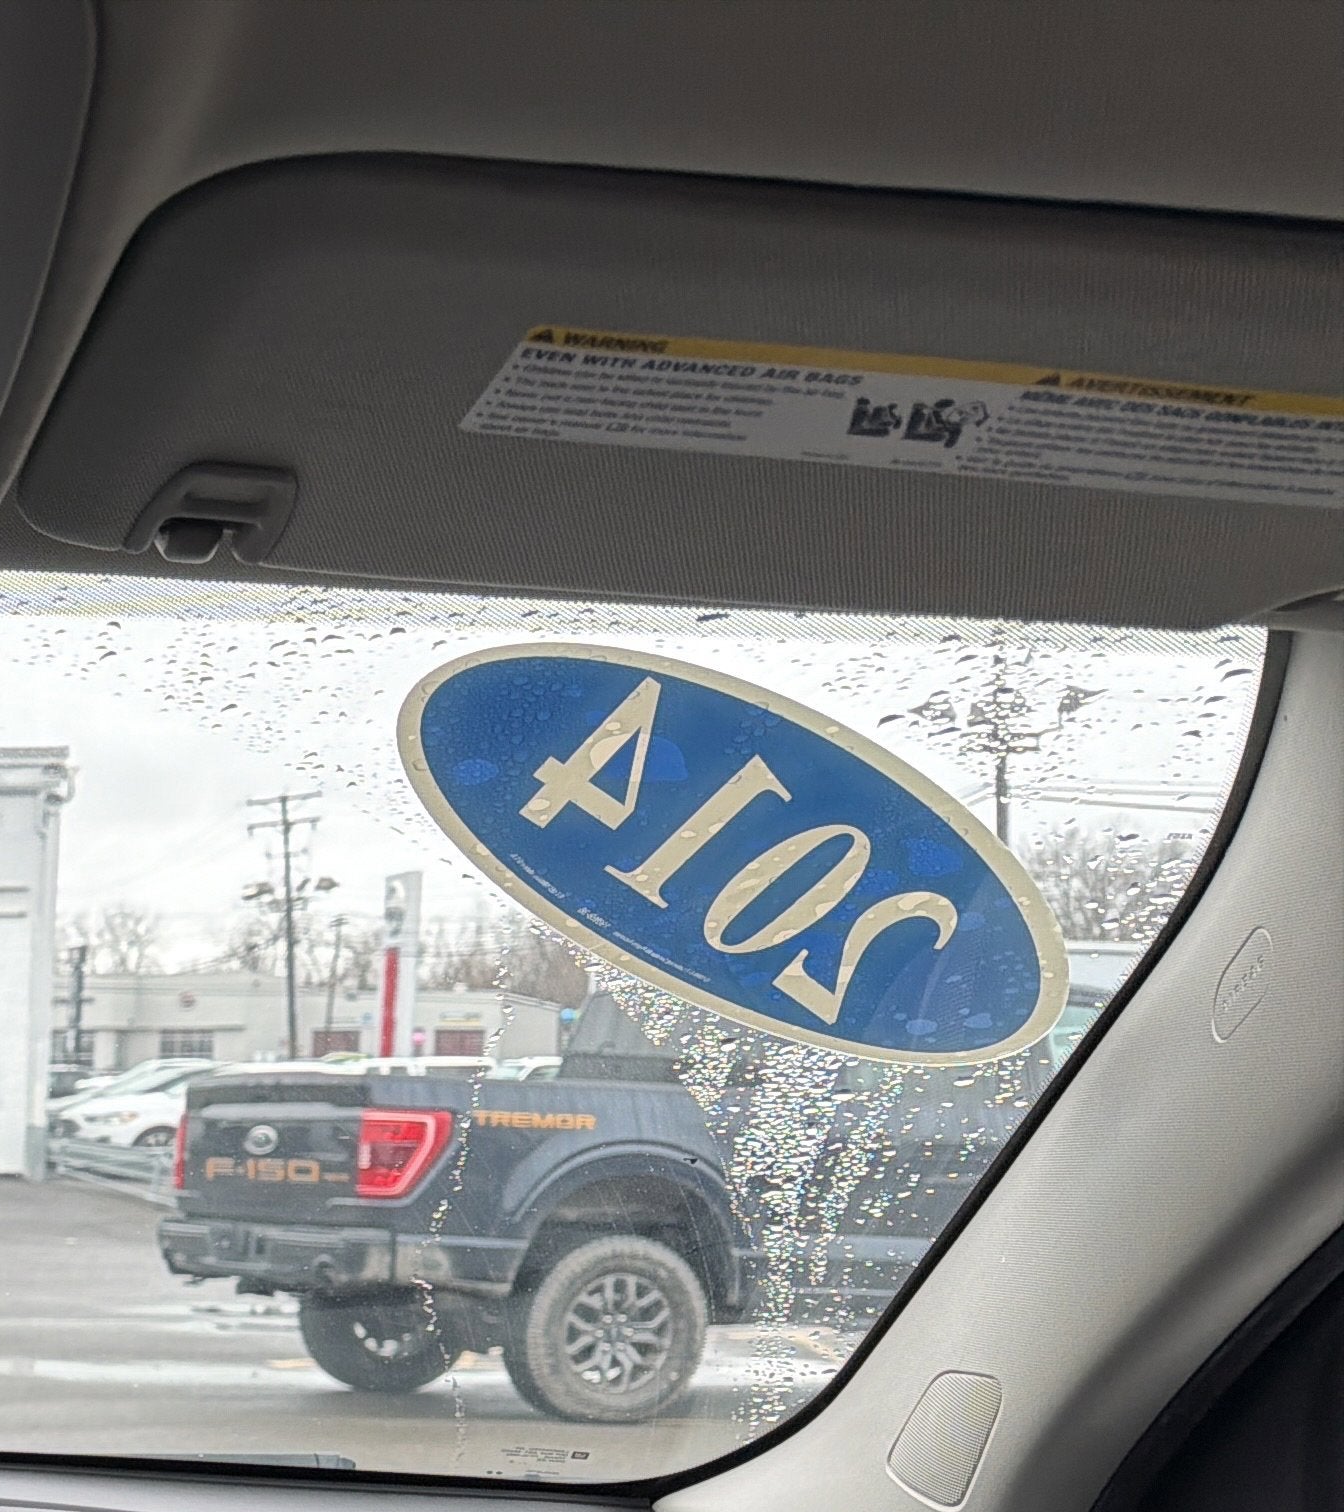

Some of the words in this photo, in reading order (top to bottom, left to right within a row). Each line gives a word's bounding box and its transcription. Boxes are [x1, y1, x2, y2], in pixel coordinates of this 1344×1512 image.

[563, 331, 669, 354] WARNING
[520, 348, 576, 363] EVEN
[582, 354, 636, 369] WITH
[641, 358, 757, 377] ADVANCED
[759, 367, 801, 381] AIR
[804, 371, 864, 386] BAGS
[472, 1109, 596, 1131] TREMOR
[204, 1157, 321, 1182] F-150
